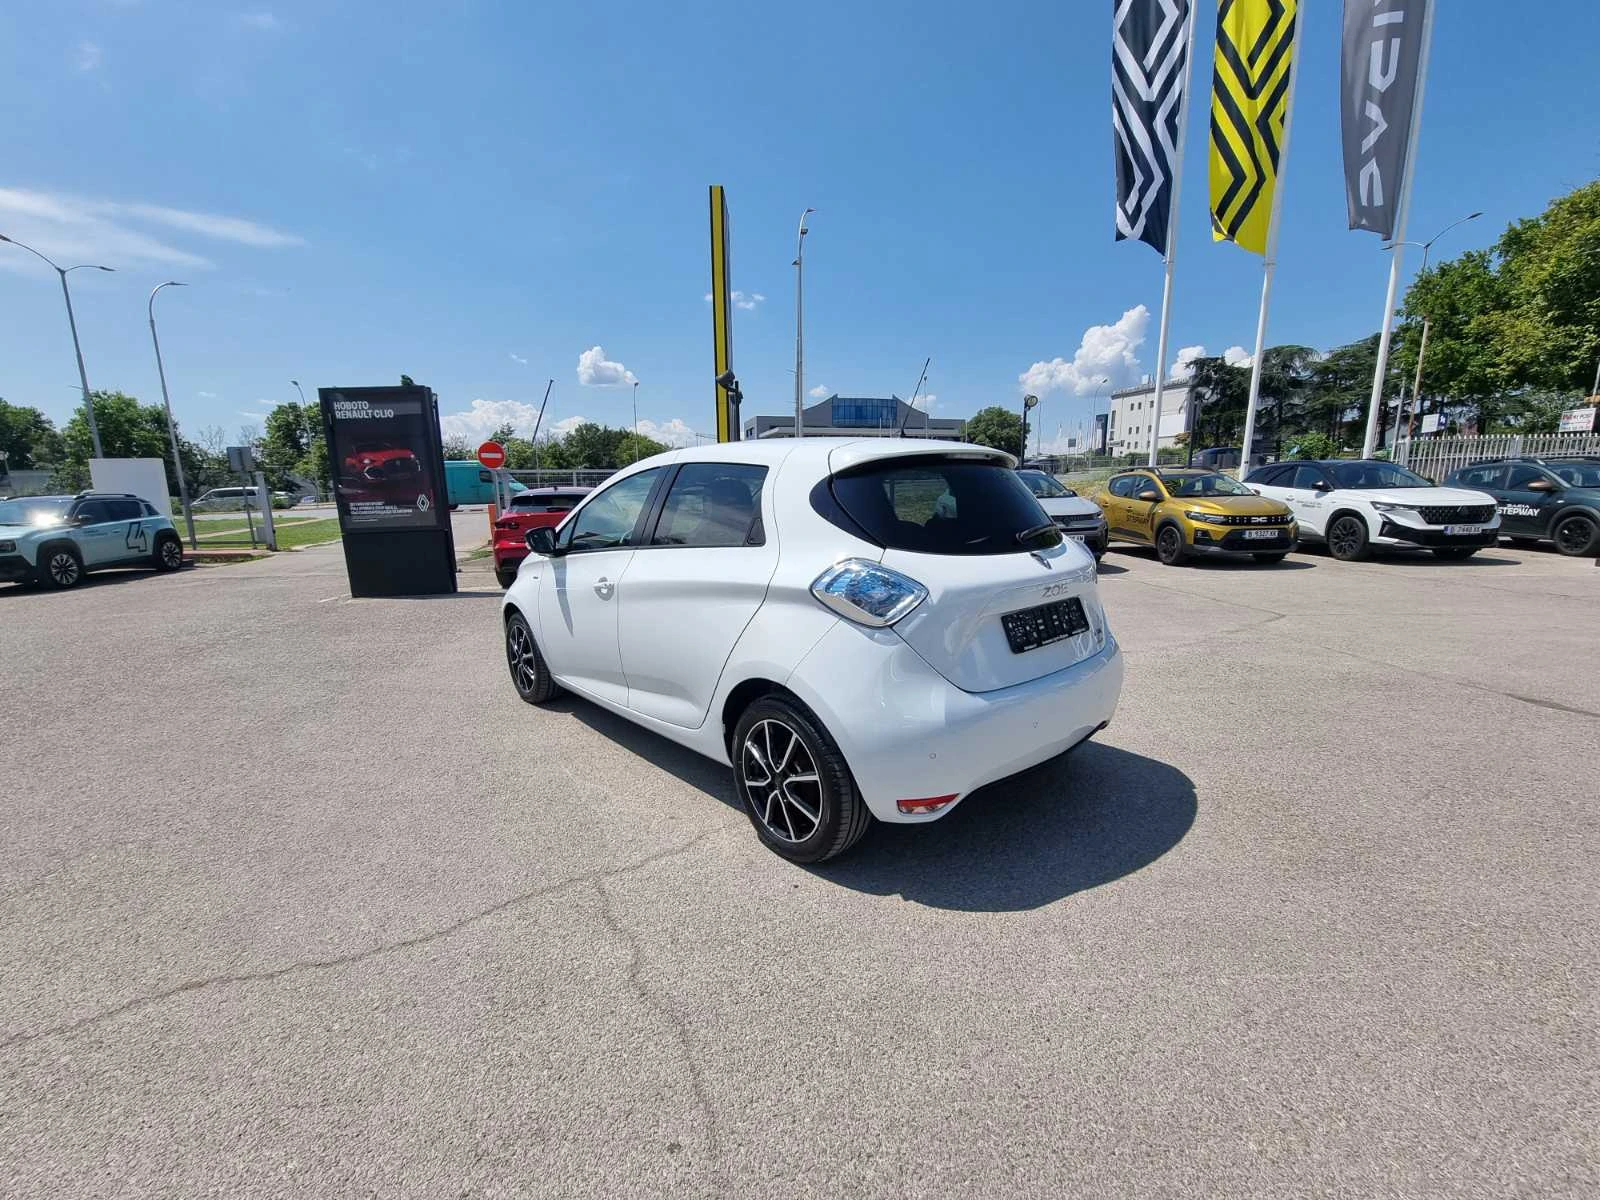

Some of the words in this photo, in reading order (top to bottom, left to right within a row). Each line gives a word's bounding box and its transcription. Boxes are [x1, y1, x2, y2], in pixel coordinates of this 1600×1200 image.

[335, 409, 373, 419] RENAULT
[374, 409, 394, 418] CLIO
[1497, 507, 1541, 516] STEPWAY
[1040, 584, 1069, 598] ZOE
